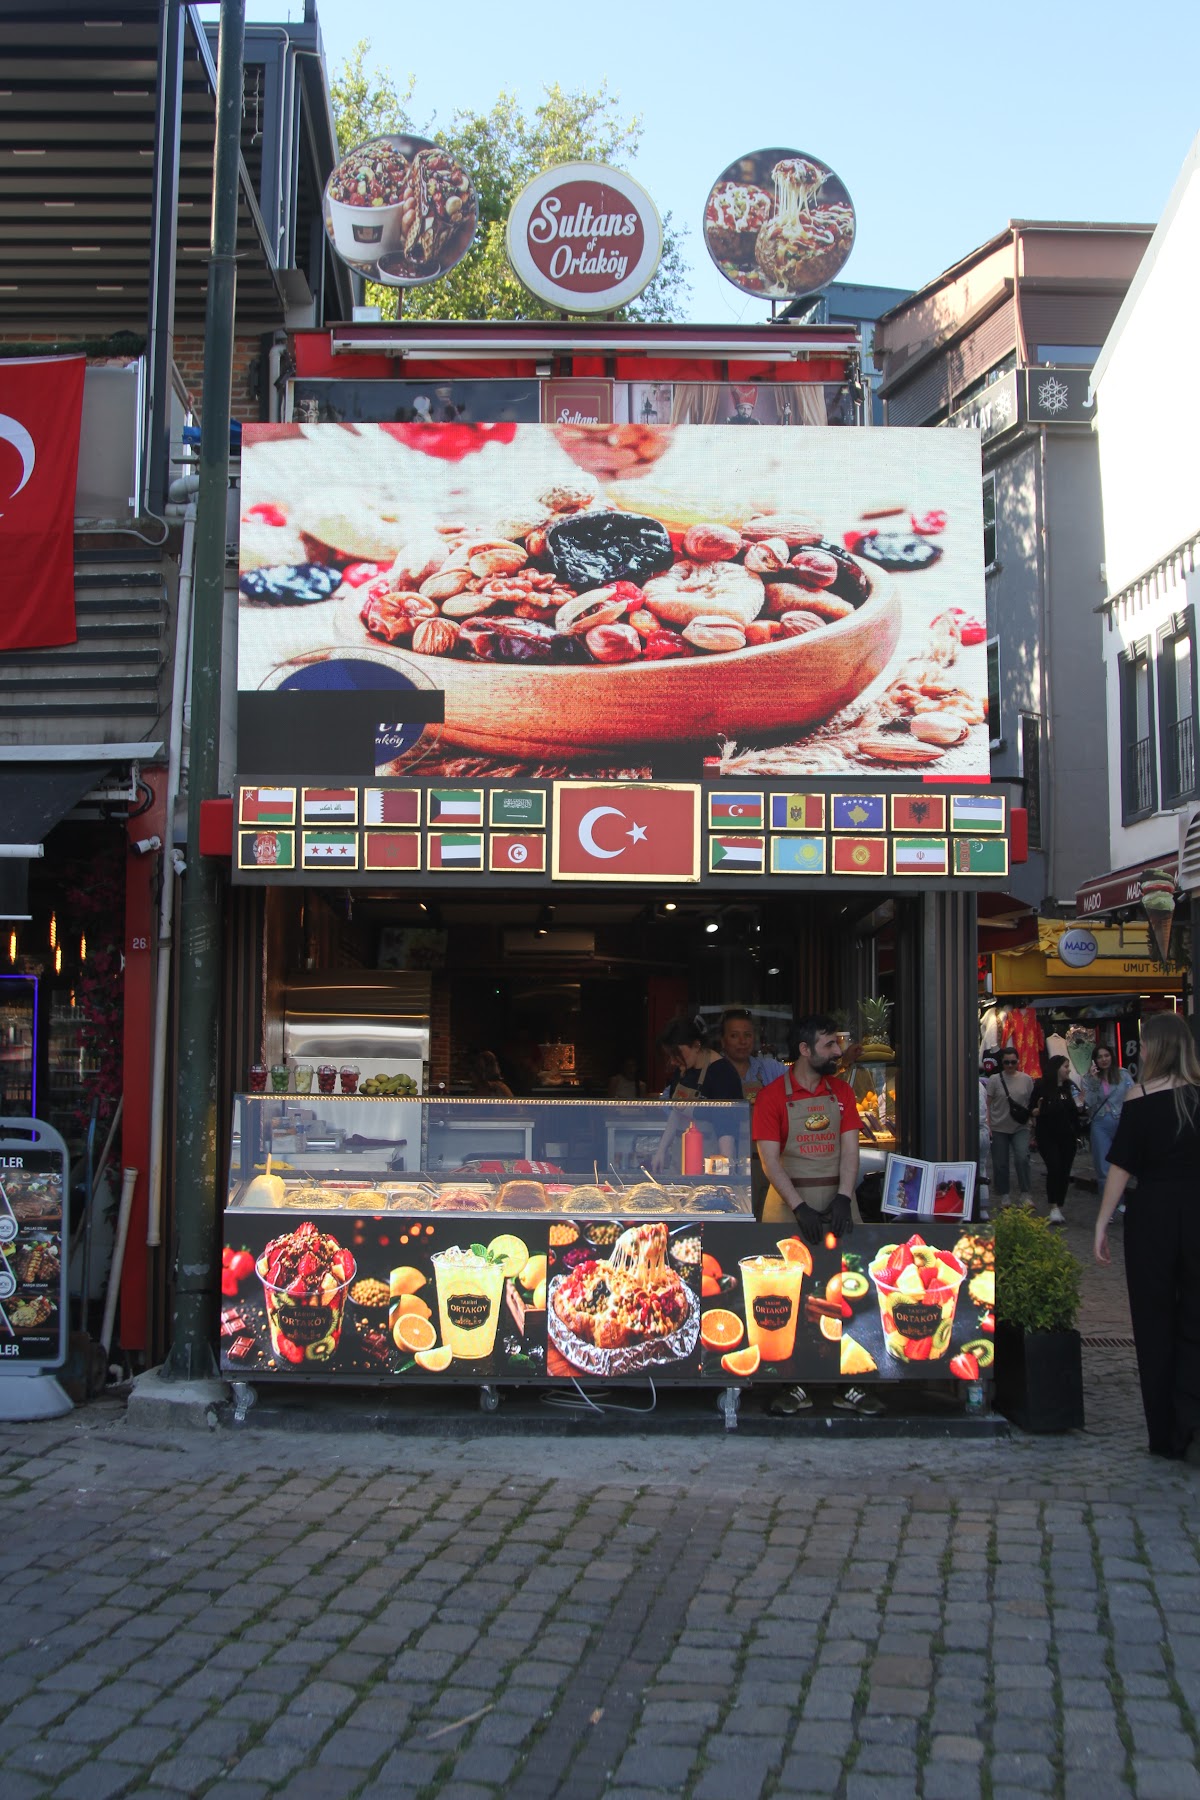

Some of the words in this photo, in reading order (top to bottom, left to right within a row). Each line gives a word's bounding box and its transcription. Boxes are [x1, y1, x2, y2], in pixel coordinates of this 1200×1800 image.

[529, 196, 637, 243] Sultans
[586, 236, 597, 251] of
[549, 244, 629, 280] Ortaköy
[556, 408, 599, 424] Sultans
[1126, 881, 1143, 900] MAD
[1083, 892, 1102, 912] MADO
[132, 937, 147, 949] 26
[1064, 942, 1096, 952] MADO
[1123, 963, 1151, 973] UMUT
